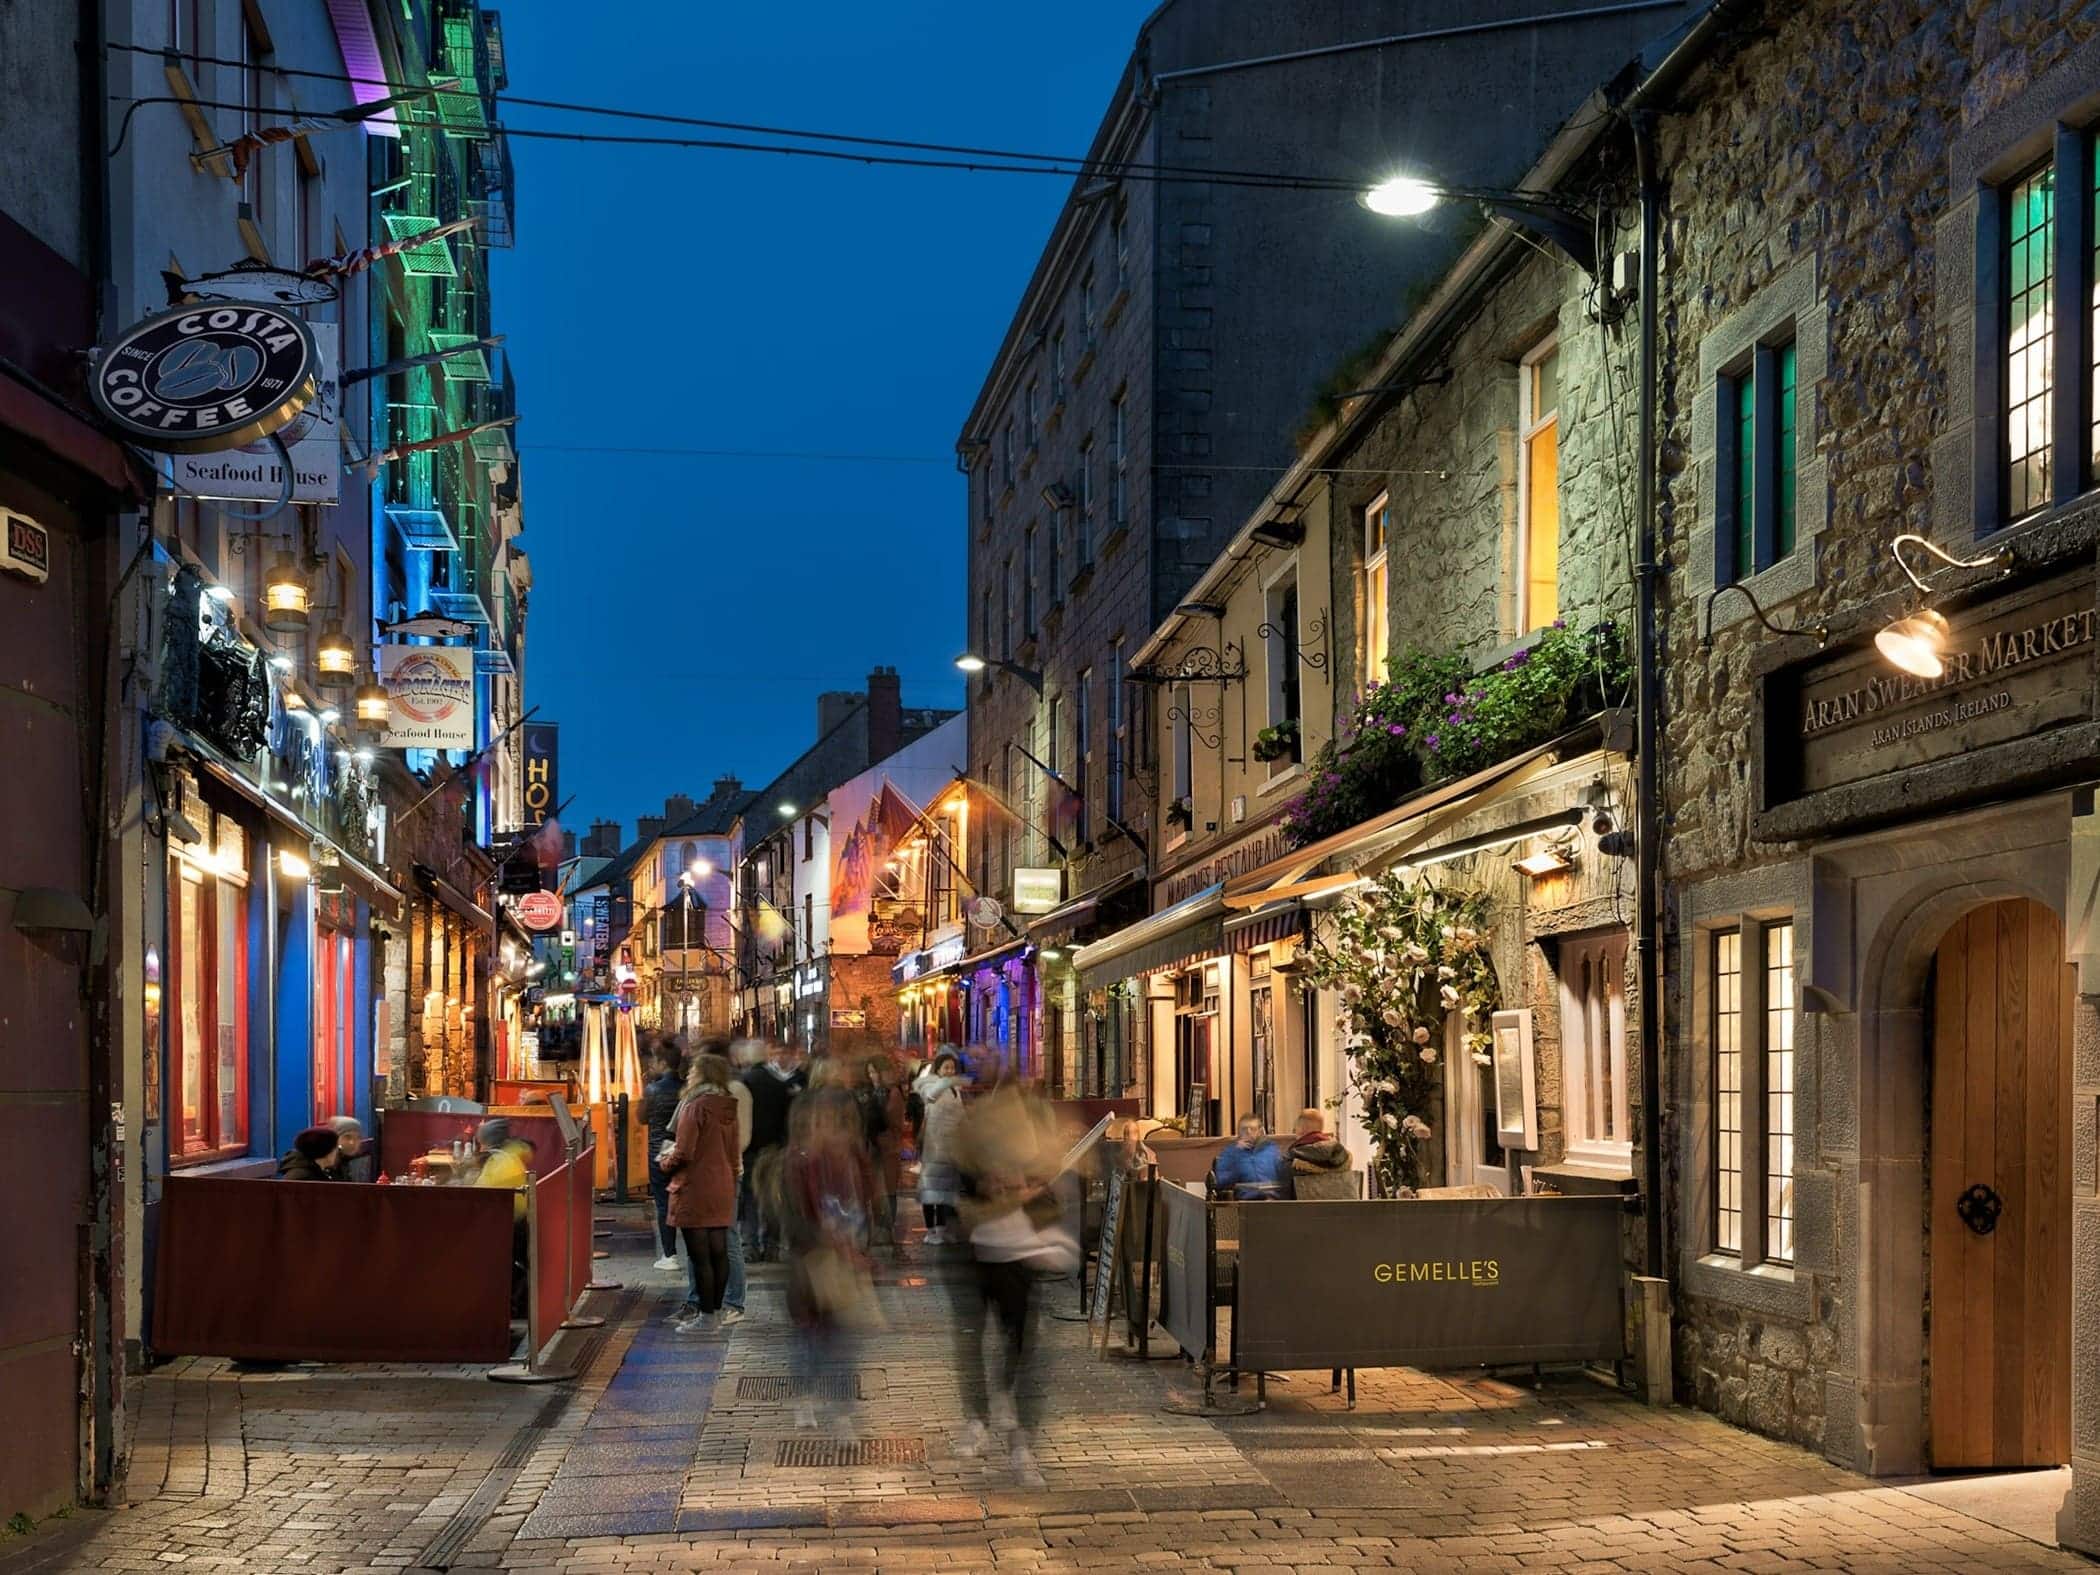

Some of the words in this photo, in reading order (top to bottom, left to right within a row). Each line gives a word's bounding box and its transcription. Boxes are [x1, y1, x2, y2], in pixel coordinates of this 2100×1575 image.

[177, 309, 298, 354] COSTA
[121, 346, 155, 362] SINCE
[260, 377, 284, 390] 1971
[106, 368, 254, 429] COFFEE
[185, 461, 263, 482] Seafood
[270, 465, 328, 487] Huse
[1802, 688, 1861, 734] ARAN
[1978, 607, 2097, 676] MARKET
[1870, 725, 1899, 747] ARAN
[1953, 691, 2010, 722] IRELAND
[434, 728, 467, 739] House
[1373, 1260, 1500, 1283] GEMELLE'S
